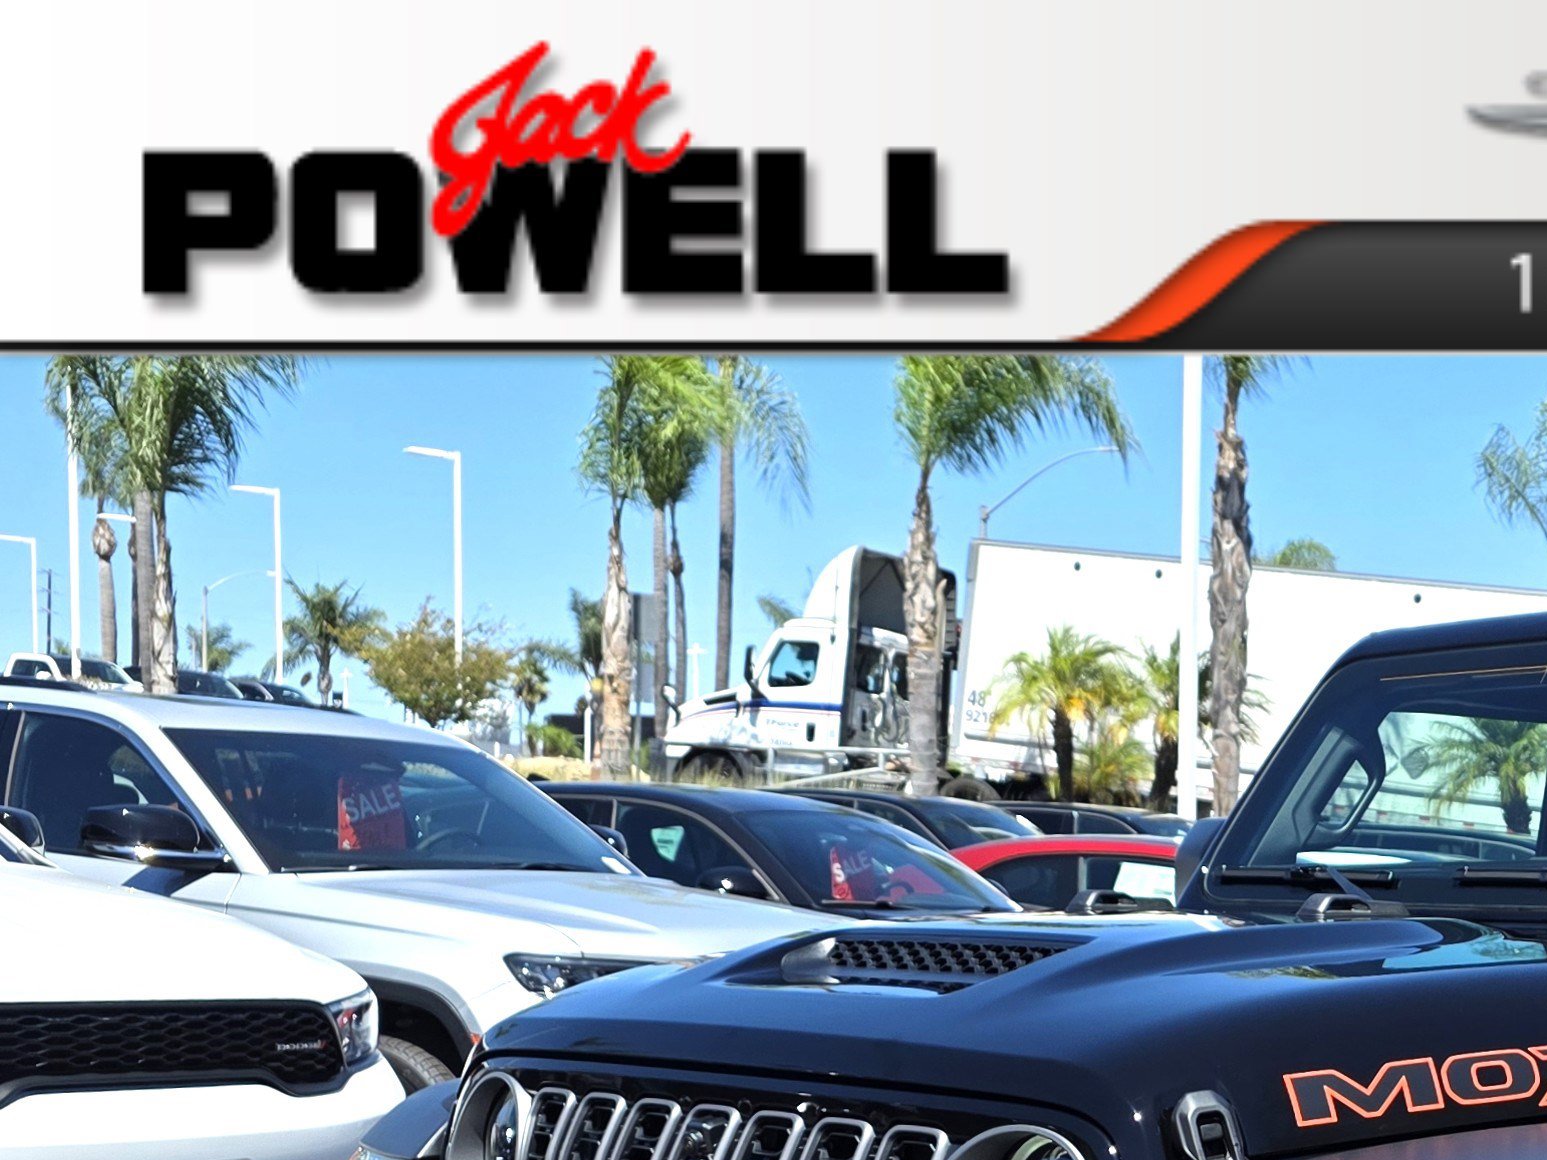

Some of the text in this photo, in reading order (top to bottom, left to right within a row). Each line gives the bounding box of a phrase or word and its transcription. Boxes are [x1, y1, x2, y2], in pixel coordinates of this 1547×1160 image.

[967, 690, 987, 708] 48
[342, 783, 401, 824] SALE
[832, 850, 871, 883] SALE
